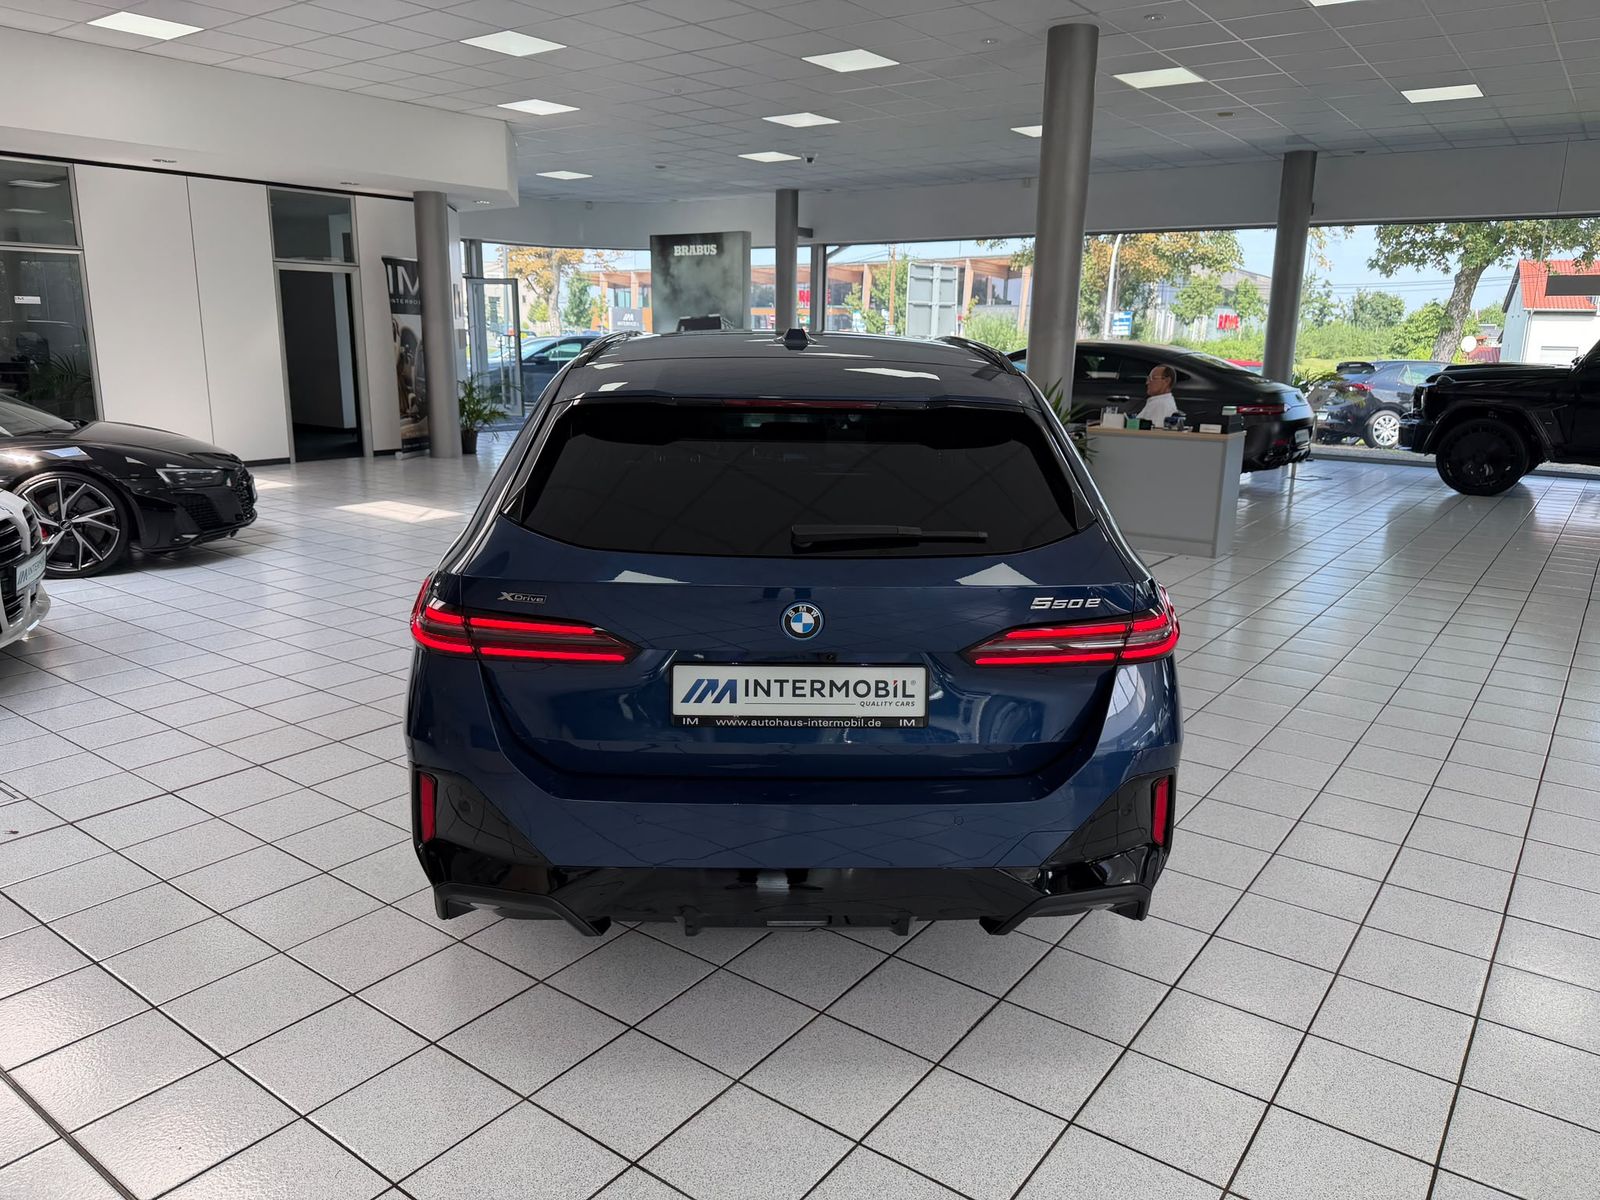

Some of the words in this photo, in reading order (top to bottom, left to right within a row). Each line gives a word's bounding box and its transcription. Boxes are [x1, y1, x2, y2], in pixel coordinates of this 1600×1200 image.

[673, 244, 718, 257] BRABUS
[787, 605, 819, 617] BMW
[859, 700, 894, 708] QUALITY
[895, 700, 916, 708] CARS
[682, 717, 699, 725] IM
[715, 718, 882, 728] www.autohaus-intermobil.de
[899, 719, 916, 727] IM
